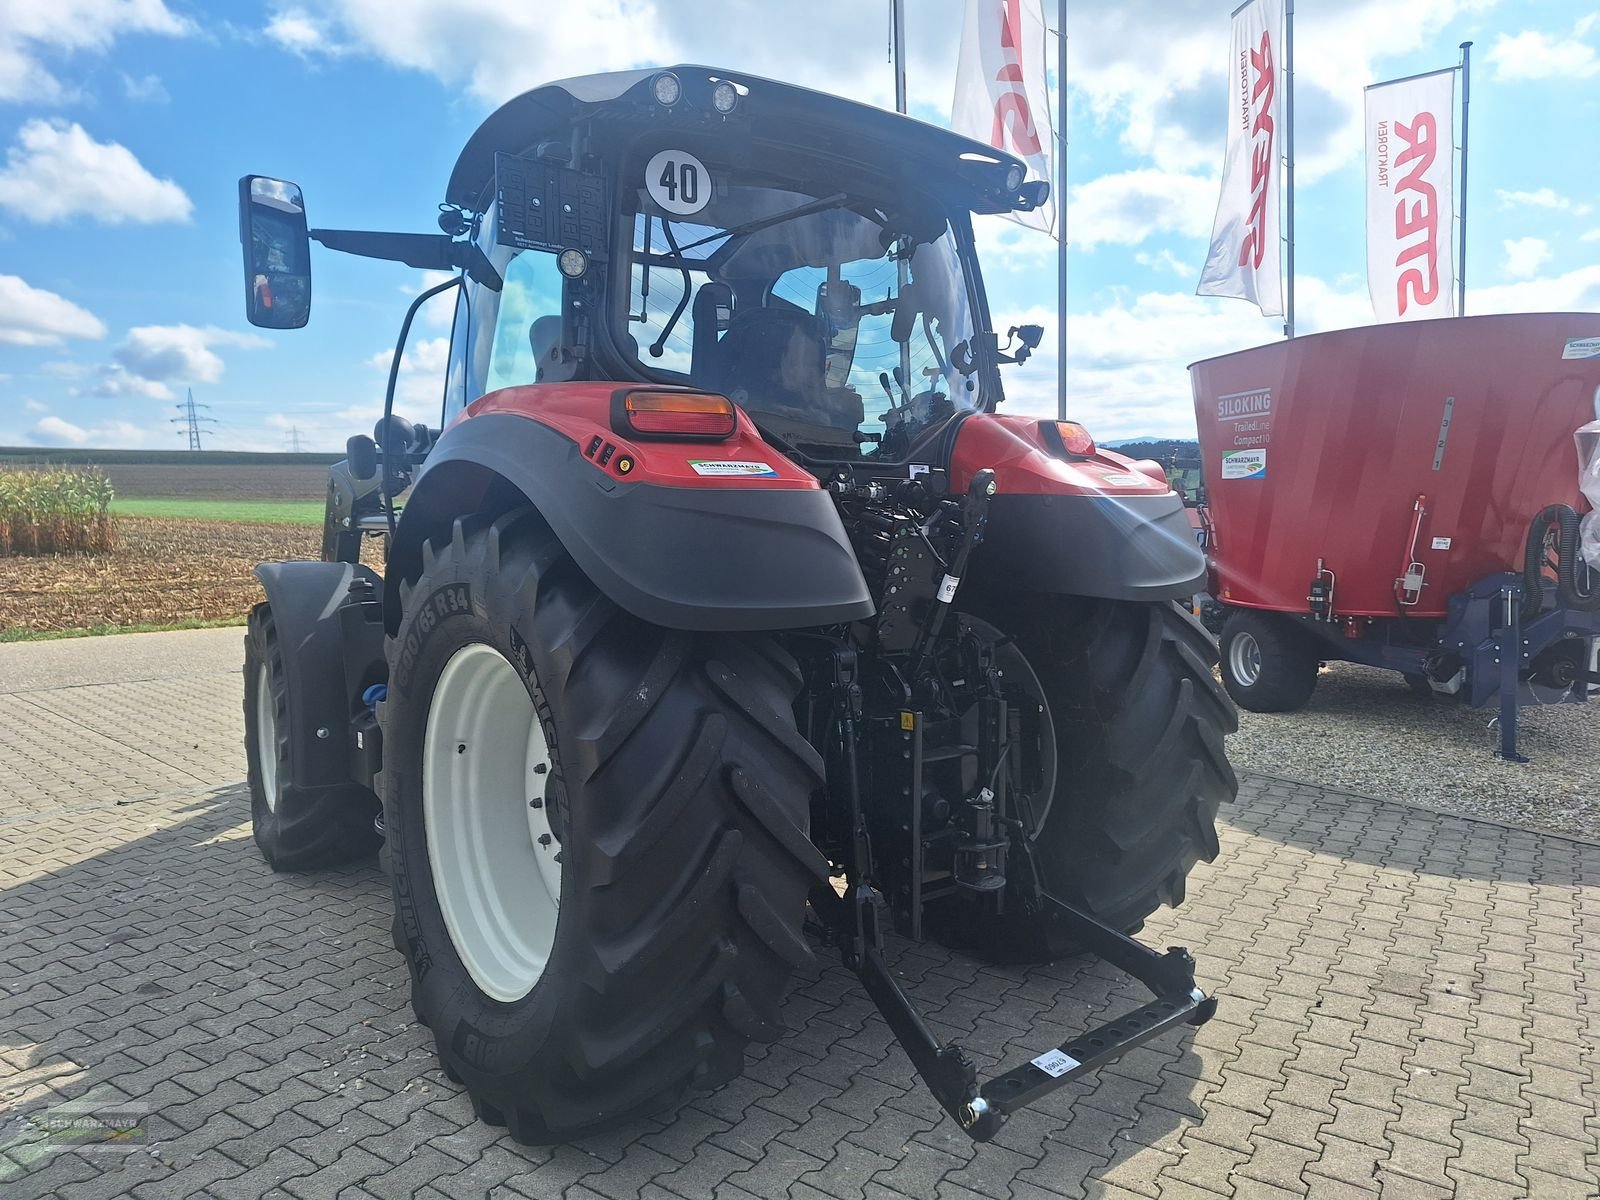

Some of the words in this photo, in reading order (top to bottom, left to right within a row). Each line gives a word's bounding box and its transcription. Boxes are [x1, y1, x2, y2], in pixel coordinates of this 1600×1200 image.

[660, 161, 698, 204] 40
[1218, 393, 1271, 416] SILOKING
[1438, 440, 1444, 448] 2
